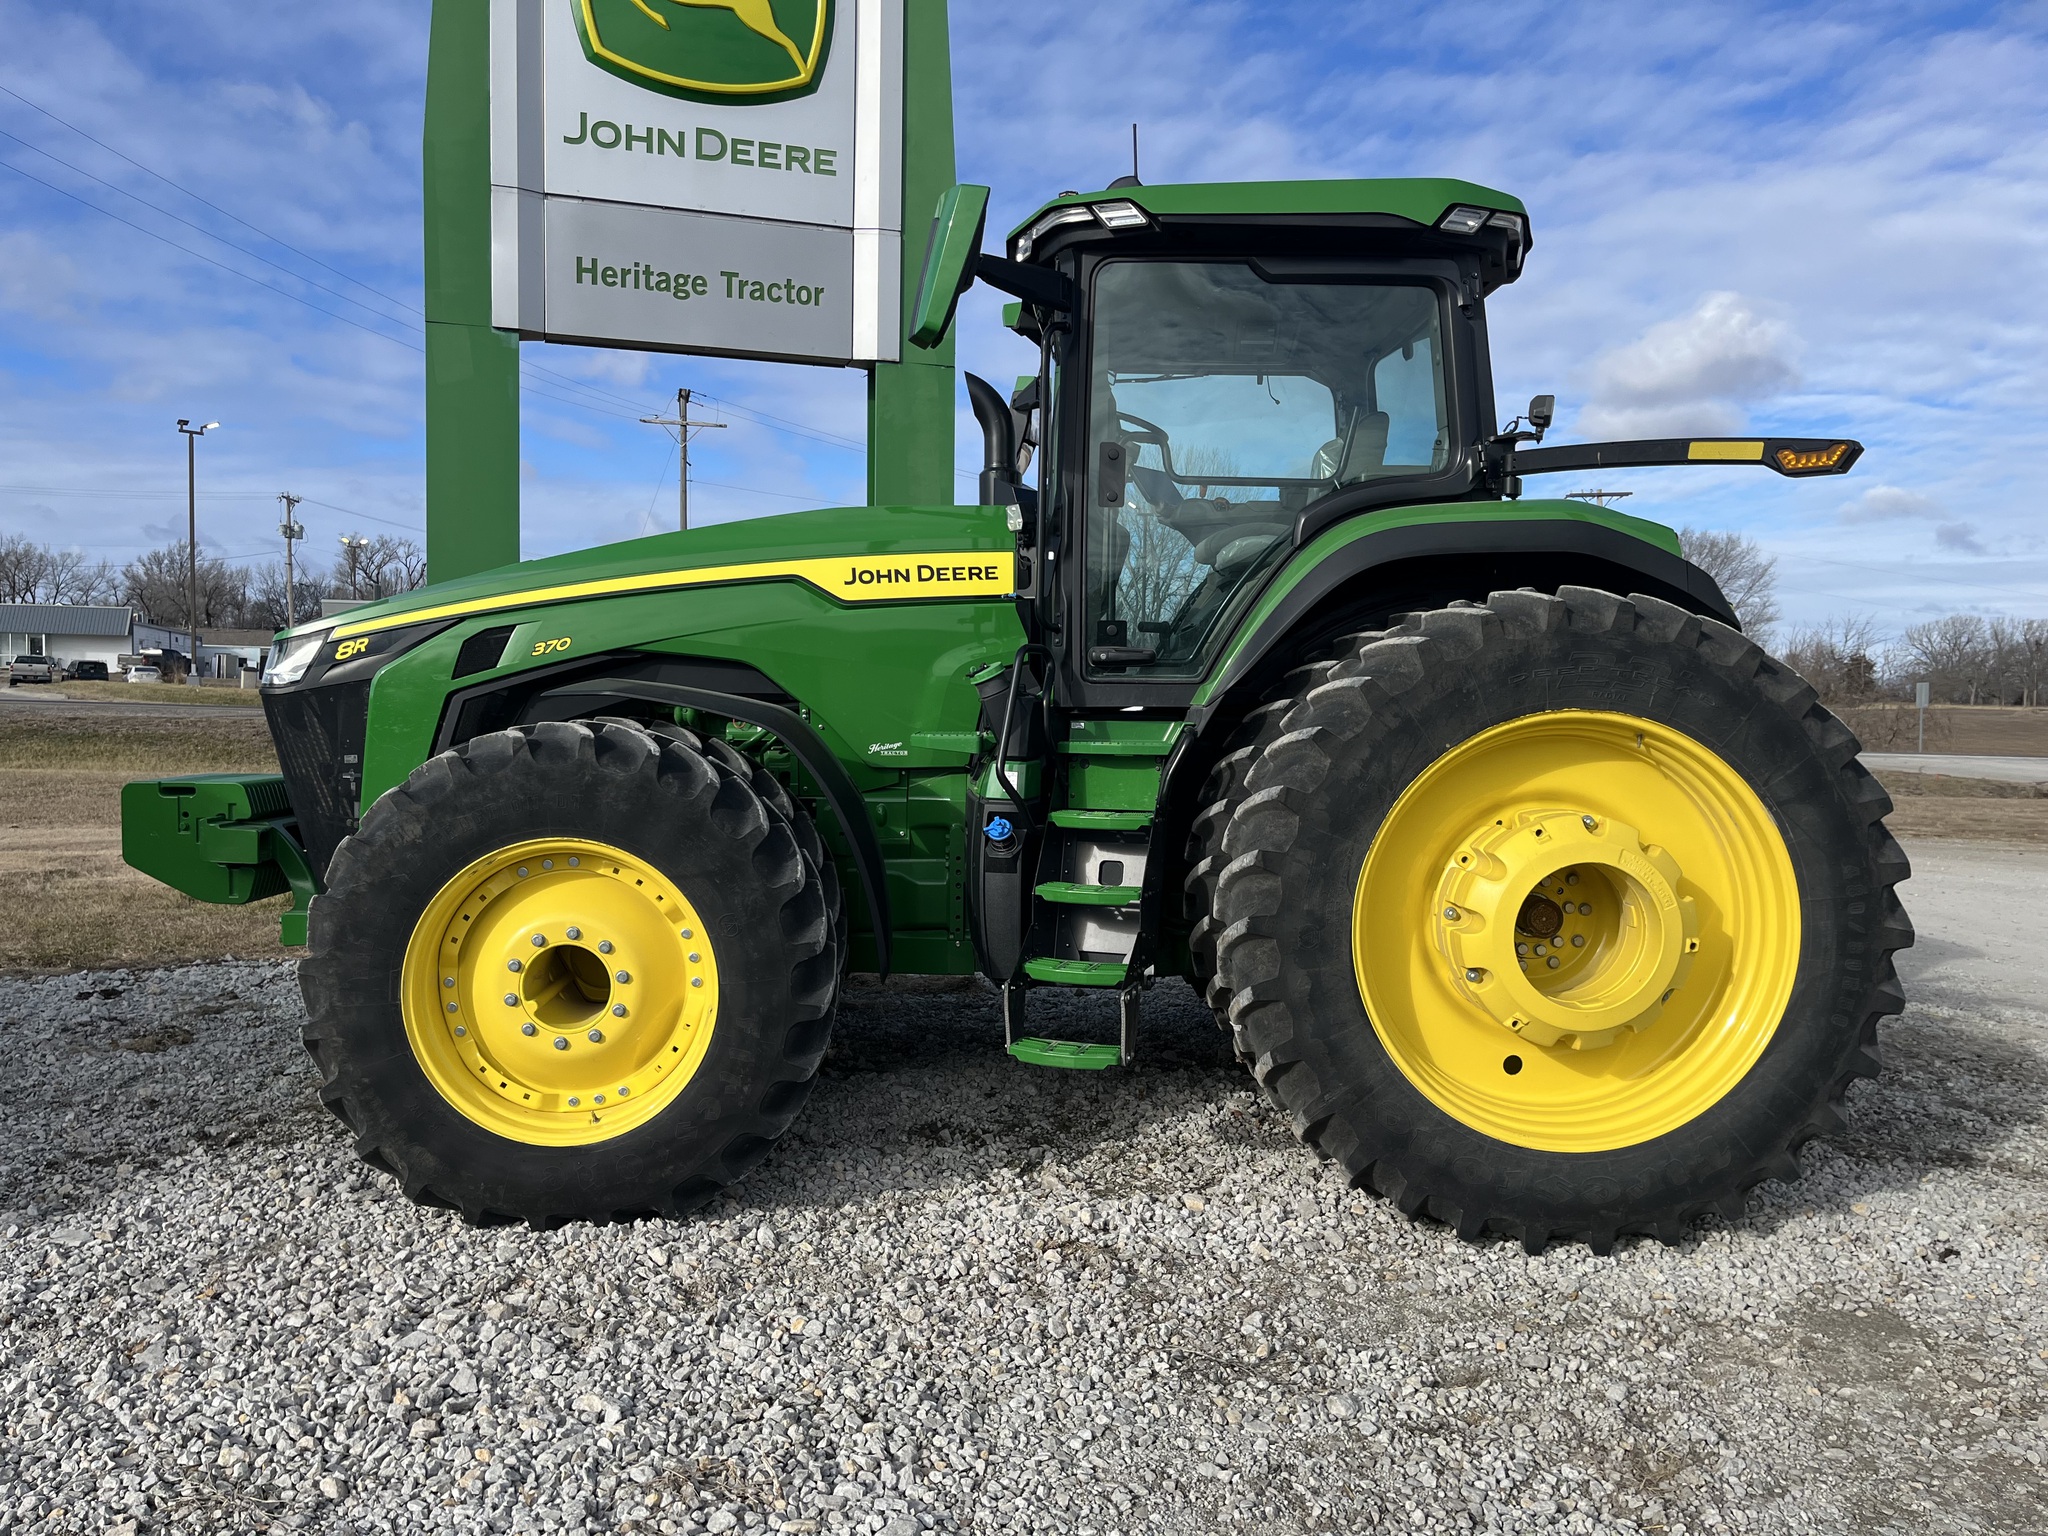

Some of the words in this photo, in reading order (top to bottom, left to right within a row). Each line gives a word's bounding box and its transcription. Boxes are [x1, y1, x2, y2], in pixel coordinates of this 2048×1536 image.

[563, 112, 686, 158] JOHN
[695, 127, 838, 177] DEERE
[575, 256, 708, 300] Heritage
[720, 271, 825, 307] Tractor
[844, 567, 911, 586] JOHN
[917, 564, 999, 583] DEERE
[334, 637, 370, 661] 8R
[531, 636, 572, 657] 370
[1508, 665, 1598, 685] DEEP
[868, 741, 903, 754] Heritage
